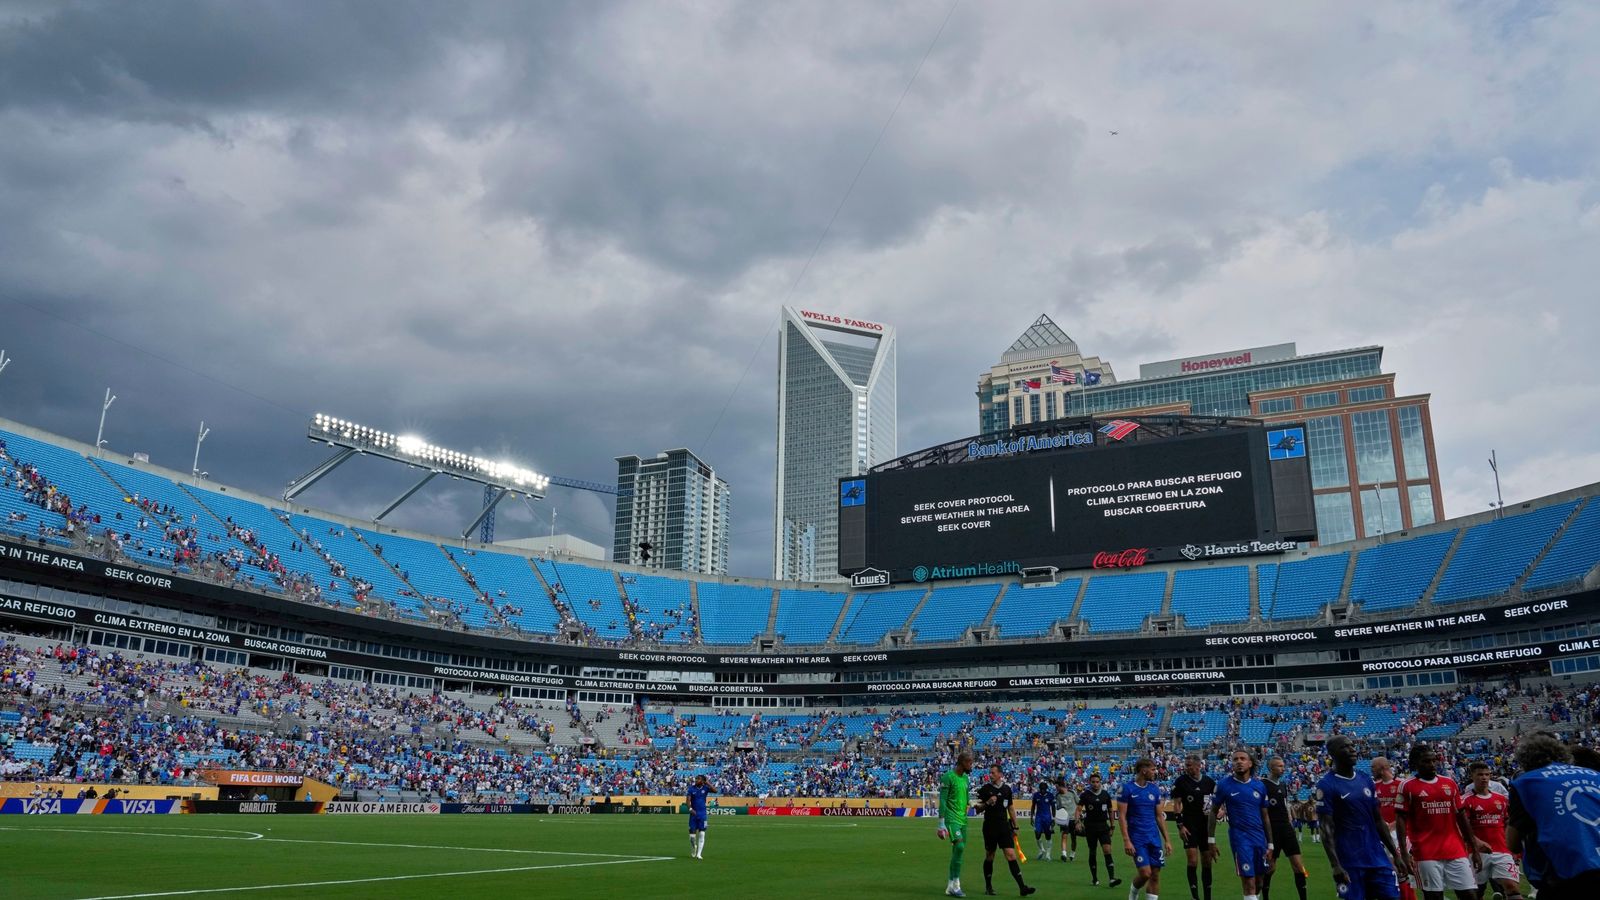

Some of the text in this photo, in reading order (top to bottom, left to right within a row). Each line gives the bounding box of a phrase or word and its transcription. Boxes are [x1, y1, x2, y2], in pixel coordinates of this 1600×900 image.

[800, 310, 883, 331] WELLS FARGO
[1181, 352, 1251, 372] Honeywell
[968, 431, 1093, 457] Bank of America
[1068, 471, 1241, 495] PROTOCOLO PARA BUSCAR REFUGIO
[914, 495, 1014, 511] SEEK COVER PROTOCOL
[1087, 497, 1115, 505] CLIMA
[1118, 492, 1162, 503] EXTREMO
[1196, 486, 1223, 495] ZONA
[901, 515, 932, 523] SEVERE
[935, 511, 974, 520] WEATHER
[1006, 505, 1029, 513] AREA
[1104, 501, 1206, 516] BUSCAR COBERTURA
[962, 521, 990, 529] COVER
[1204, 540, 1296, 556] Harris Teeter
[9, 548, 21, 558] IN
[26, 551, 49, 563] THE
[52, 557, 83, 571] AREA
[931, 561, 1020, 578] Atrium Health
[105, 568, 171, 588] SEEK COVER
[855, 574, 886, 585] LOWE'S
[24, 602, 76, 618] REFUGIO
[1505, 600, 1568, 617] SEEK COVER
[95, 614, 229, 643] CLIMA EXTREMO EN LA ZONA
[1335, 614, 1485, 637] SEVERE WEATHER IN THE AREA
[1266, 632, 1317, 642] PROTOCOL
[245, 637, 328, 659] BUSCAR COBERTURA
[1559, 641, 1590, 651] CLIMA
[1363, 648, 1541, 670] PROTOCOLO PARA BUSCAR REFUGIO
[434, 667, 478, 678] PROTOCOLO
[500, 674, 529, 684] BUSCAR
[1172, 672, 1224, 680] COBERTURA
[230, 774, 249, 782] FIFA
[251, 775, 273, 783] CLUB
[1421, 800, 1452, 809] Emirates
[1553, 779, 1600, 815] CLUB WORL
[120, 800, 156, 814] VISA
[239, 802, 277, 813] CHARLOTTE
[328, 803, 426, 813] BANK OF AMERICA
[491, 805, 512, 813] ULTRA
[558, 805, 591, 814] motorola
[705, 807, 736, 815] sense
[823, 806, 893, 817] QATAR AIRWAYS
[923, 808, 939, 817] VIS
